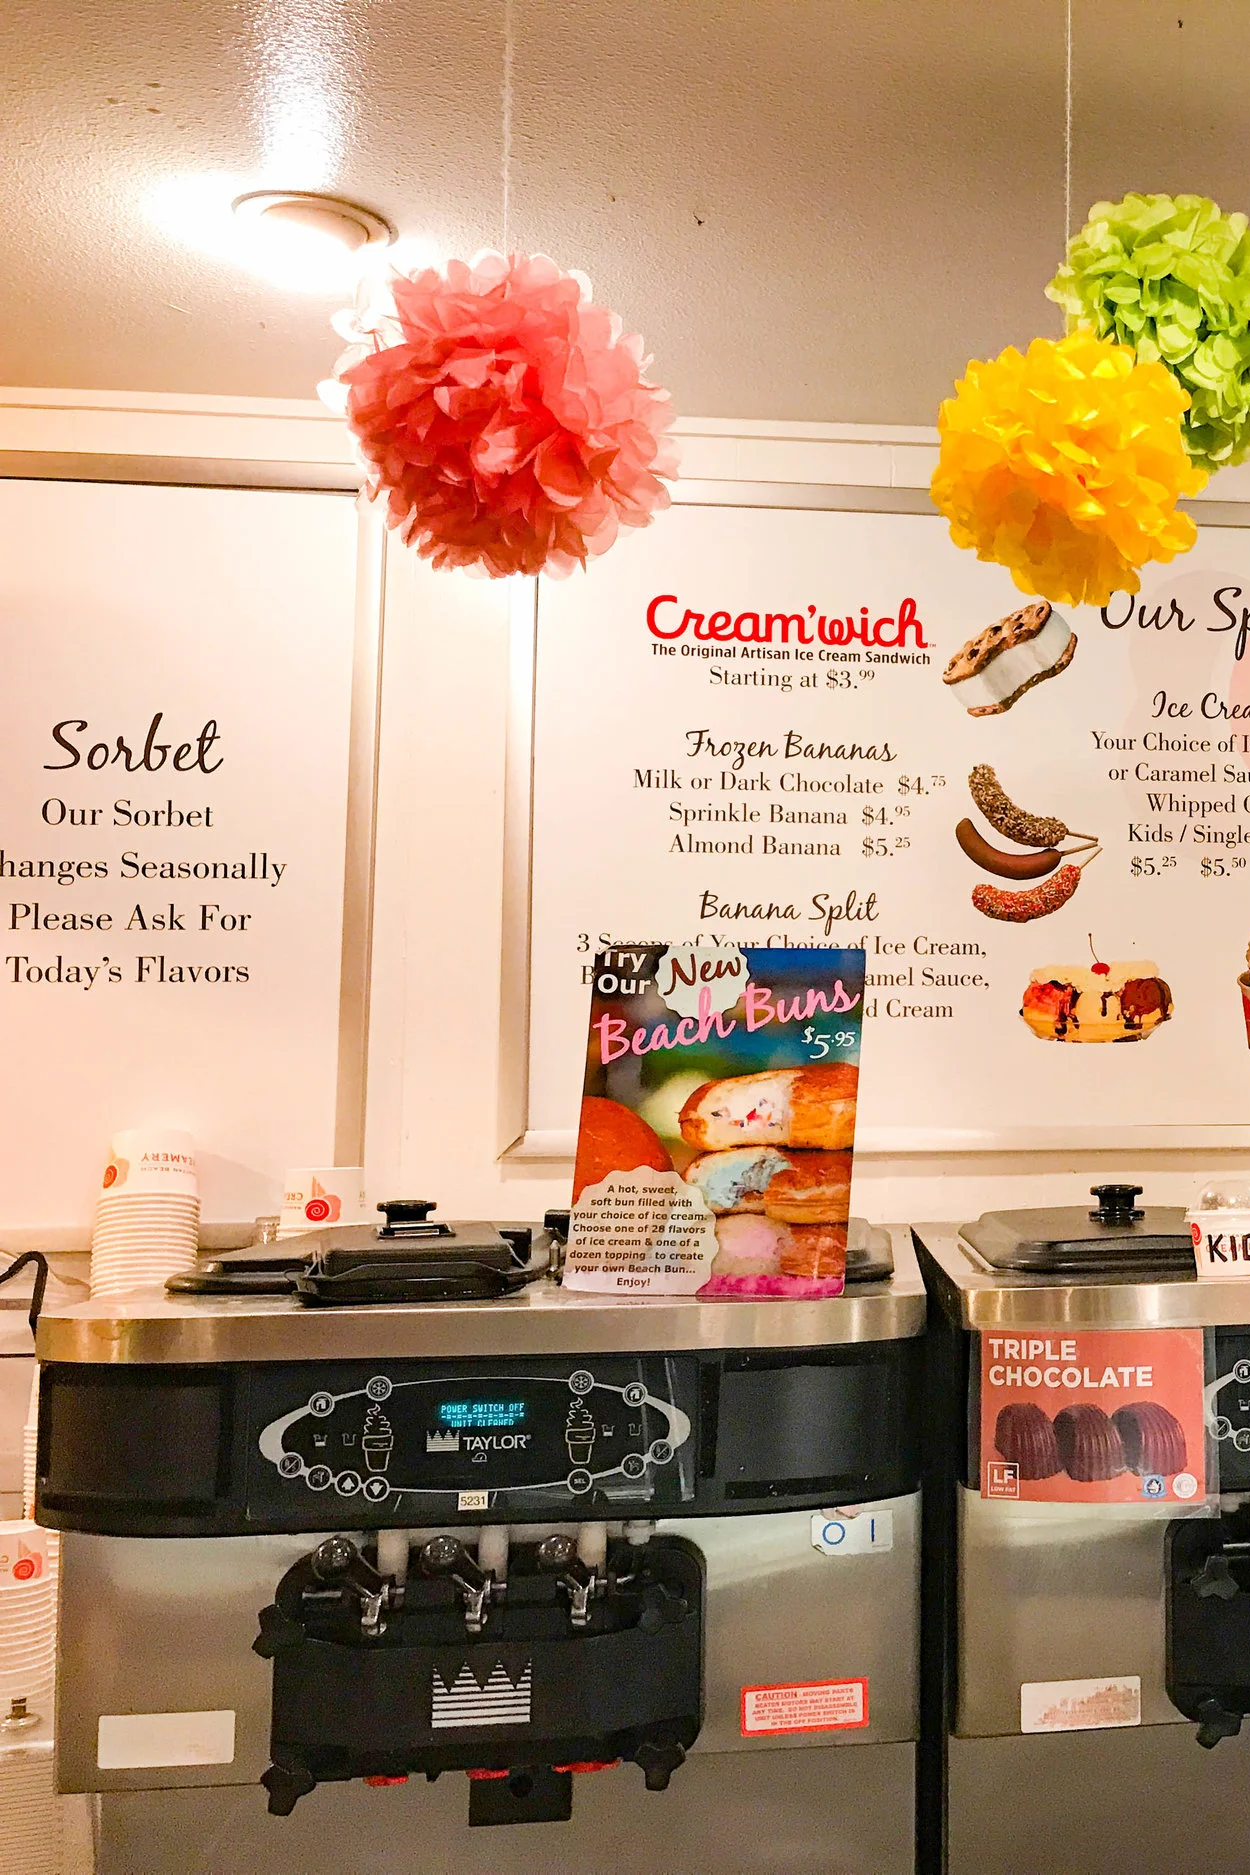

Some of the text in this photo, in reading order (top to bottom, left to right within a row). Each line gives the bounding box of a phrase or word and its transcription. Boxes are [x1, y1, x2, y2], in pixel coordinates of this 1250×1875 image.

[1100, 591, 1195, 632] Our
[651, 643, 931, 665] The Original Artisan Ice Cream Sandwich
[709, 666, 793, 693] Starting
[799, 672, 817, 688] at
[1151, 690, 1194, 719] Ice
[43, 711, 224, 774] Sorbet
[685, 728, 898, 771] Frozen Bananas
[1091, 730, 1137, 751] Your
[1142, 732, 1211, 752] Choice
[1217, 734, 1238, 753] of
[634, 768, 683, 789] Milk
[690, 777, 713, 790] or
[721, 771, 771, 791] Dark
[779, 772, 884, 794] Chocolate
[41, 797, 212, 828] Our Sorbet
[669, 802, 761, 827] Sprinkle
[770, 803, 847, 825] Banana
[1128, 823, 1174, 843] Kids
[668, 833, 753, 854] Almond
[763, 835, 841, 856] Banana
[0, 849, 287, 888] hanges Seasonally
[8, 902, 252, 931] Please Ask For
[699, 889, 880, 939] Banana Split
[875, 935, 987, 956] Ice Cream,
[135, 955, 250, 983] Flavors
[663, 953, 741, 996] New
[921, 967, 990, 987] Sauce,
[597, 973, 651, 994] Our
[886, 999, 953, 1018] Cream
[592, 979, 861, 1064] Beach Buns
[606, 1184, 678, 1196] A hot, sweet,
[590, 1197, 693, 1208] soft bun filled with
[573, 1212, 598, 1221] your
[600, 1210, 635, 1220] choice
[637, 1210, 650, 1220] of
[670, 1213, 709, 1221] cream.
[616, 1277, 651, 1289] Enjoy!
[989, 1339, 1076, 1361] TRIPLE
[989, 1366, 1153, 1388] CHOCOLATE
[441, 1403, 524, 1413] POWER SWITCH OFF
[993, 1470, 1014, 1483] LF
[461, 1496, 485, 1505] 5231
[755, 1691, 797, 1701] CAUTION
